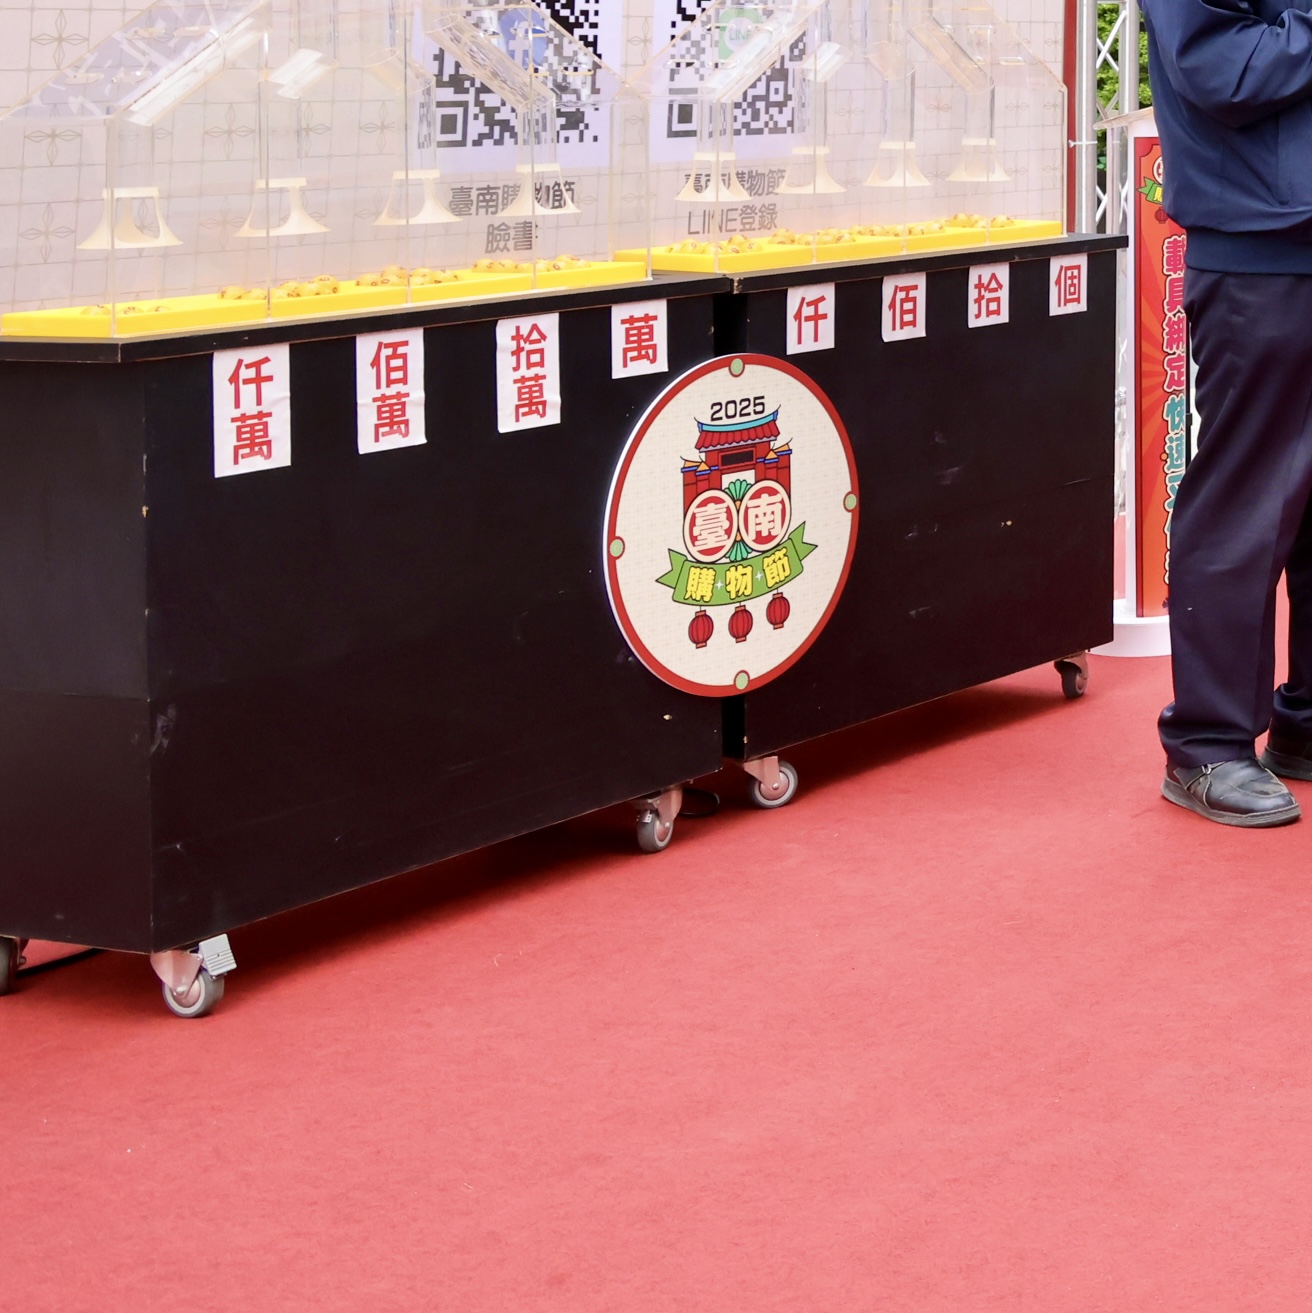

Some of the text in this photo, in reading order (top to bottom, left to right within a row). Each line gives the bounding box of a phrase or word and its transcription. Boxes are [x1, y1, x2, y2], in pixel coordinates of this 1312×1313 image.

[485, 221, 539, 254] 臉書
[888, 284, 918, 332] 佰
[973, 272, 1003, 320] 拾
[1054, 264, 1082, 308] 個
[620, 313, 658, 368] 萬
[793, 295, 828, 345] 仟
[370, 340, 410, 443] 佰萬
[511, 323, 548, 423] 拾萬
[228, 356, 273, 466] 仟萬
[710, 395, 766, 423] 2025
[691, 492, 783, 553] 臺南
[684, 546, 791, 603] 購物節
